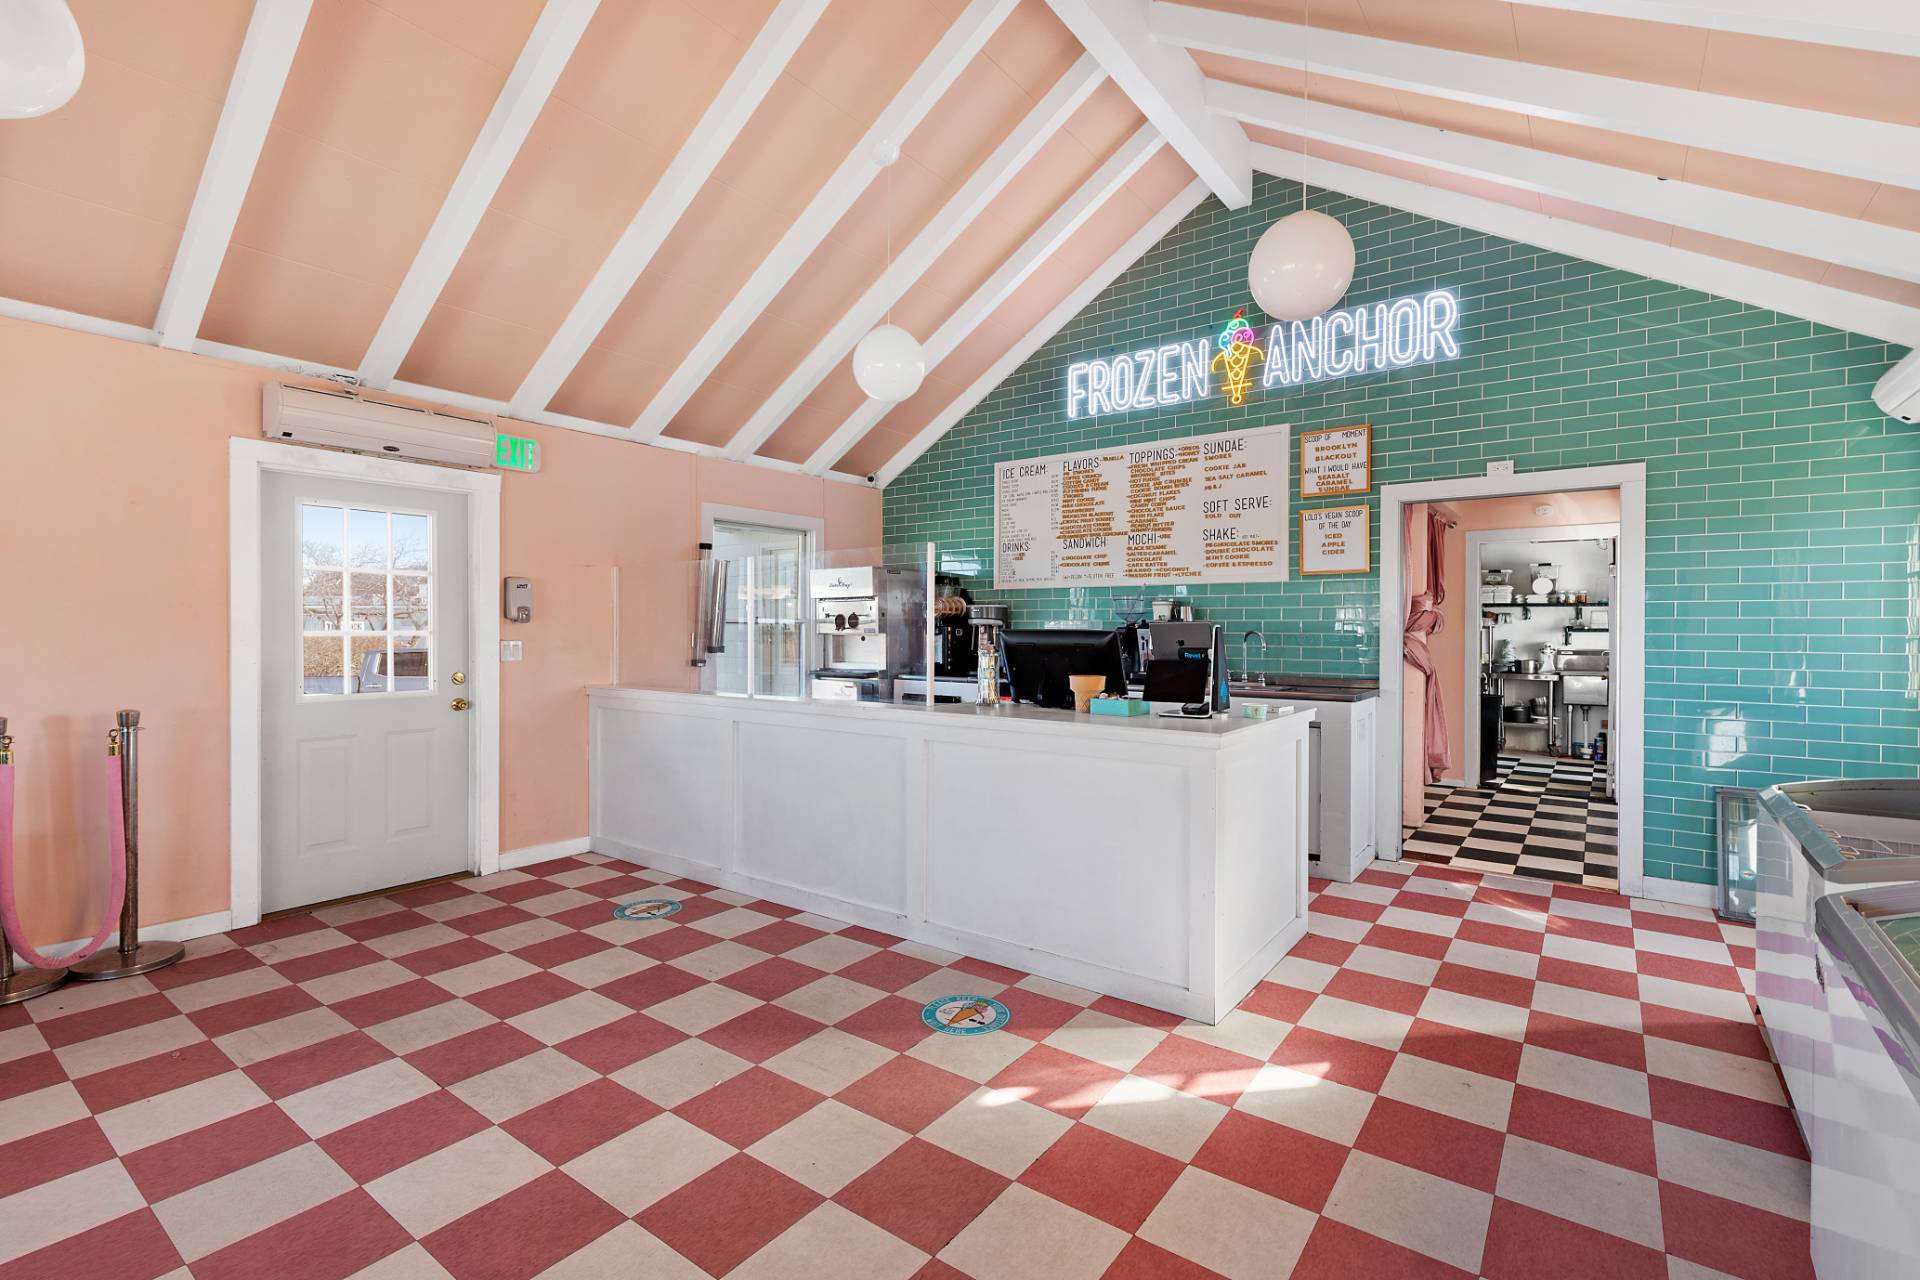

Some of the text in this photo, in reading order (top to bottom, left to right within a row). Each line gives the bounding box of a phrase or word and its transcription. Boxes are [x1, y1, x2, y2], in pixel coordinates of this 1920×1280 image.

[1067, 290, 1458, 418] FROZEN ANCHOR
[1304, 429, 1366, 443] SCOOP OF MOMENT
[497, 434, 538, 470] EXIT
[1203, 438, 1248, 455] SUNDAE:
[1315, 442, 1358, 452] BROOKLYN
[1063, 456, 1102, 471] FLAVORS:
[1130, 448, 1178, 465] TOPPINGS:
[1204, 453, 1232, 461] SMORES
[1315, 452, 1357, 462] BLACKOUT
[1003, 464, 1048, 480] ICE CREAM:
[1304, 466, 1321, 475] WHAT
[1328, 463, 1349, 473] WOULD
[1351, 461, 1367, 470] HAVE
[1316, 478, 1353, 487] CARAMEL
[1203, 495, 1271, 513] SOFT SERVE:
[1324, 510, 1343, 519] VEGAN
[1345, 509, 1363, 518] SCOOP
[1318, 520, 1352, 530] OF THE DAY
[1203, 527, 1239, 541] SHAKE:
[1002, 541, 1031, 553] DRINKS:
